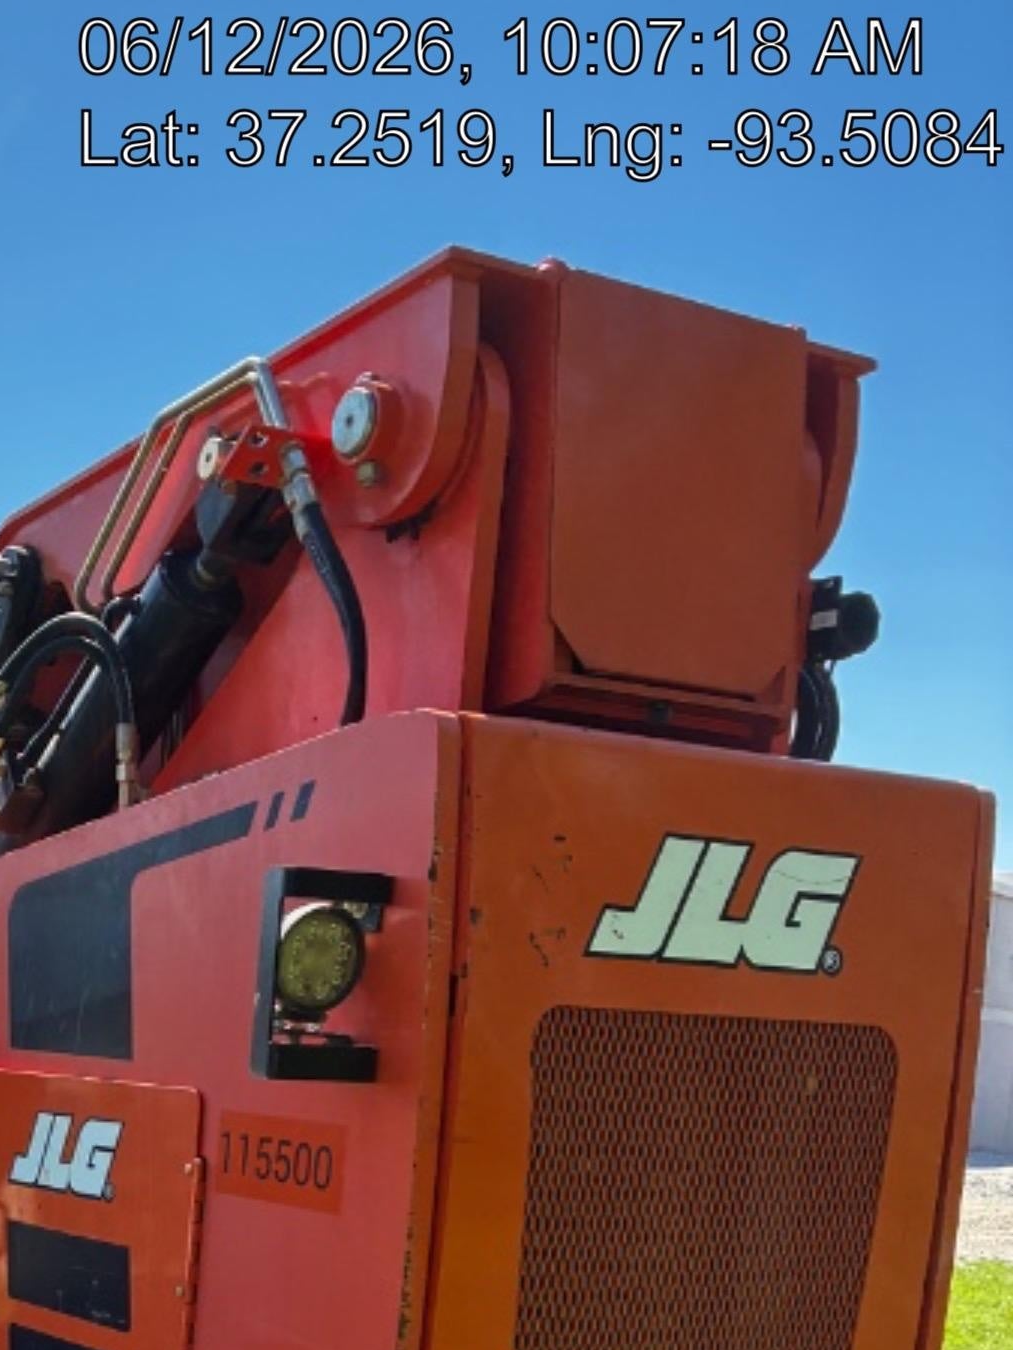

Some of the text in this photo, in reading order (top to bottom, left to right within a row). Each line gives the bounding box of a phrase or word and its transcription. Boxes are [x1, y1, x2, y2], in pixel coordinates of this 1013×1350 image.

[583, 832, 863, 975] JLG
[8, 1111, 125, 1202] JLG
[220, 1130, 334, 1191] 115500
